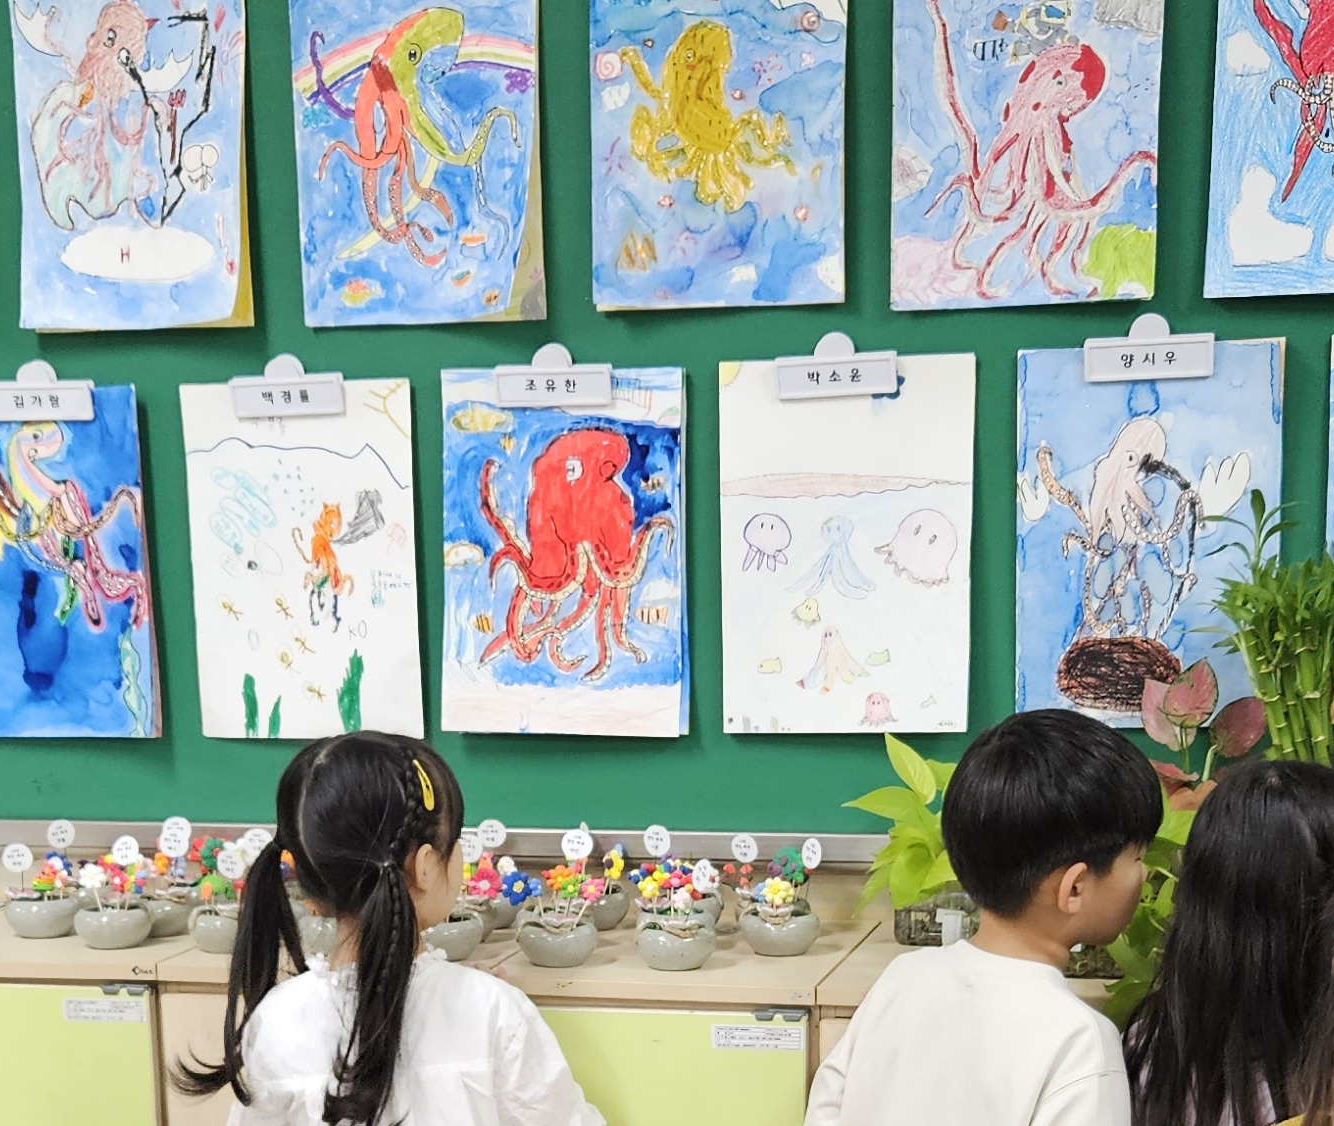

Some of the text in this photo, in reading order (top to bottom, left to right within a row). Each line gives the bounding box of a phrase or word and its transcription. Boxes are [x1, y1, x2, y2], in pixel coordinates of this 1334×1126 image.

[1120, 351, 1178, 368] 양시우
[807, 368, 862, 384] 박소윤
[525, 379, 577, 394] 조유한
[13, 395, 60, 409] 김가람
[261, 389, 310, 405] 백경률
